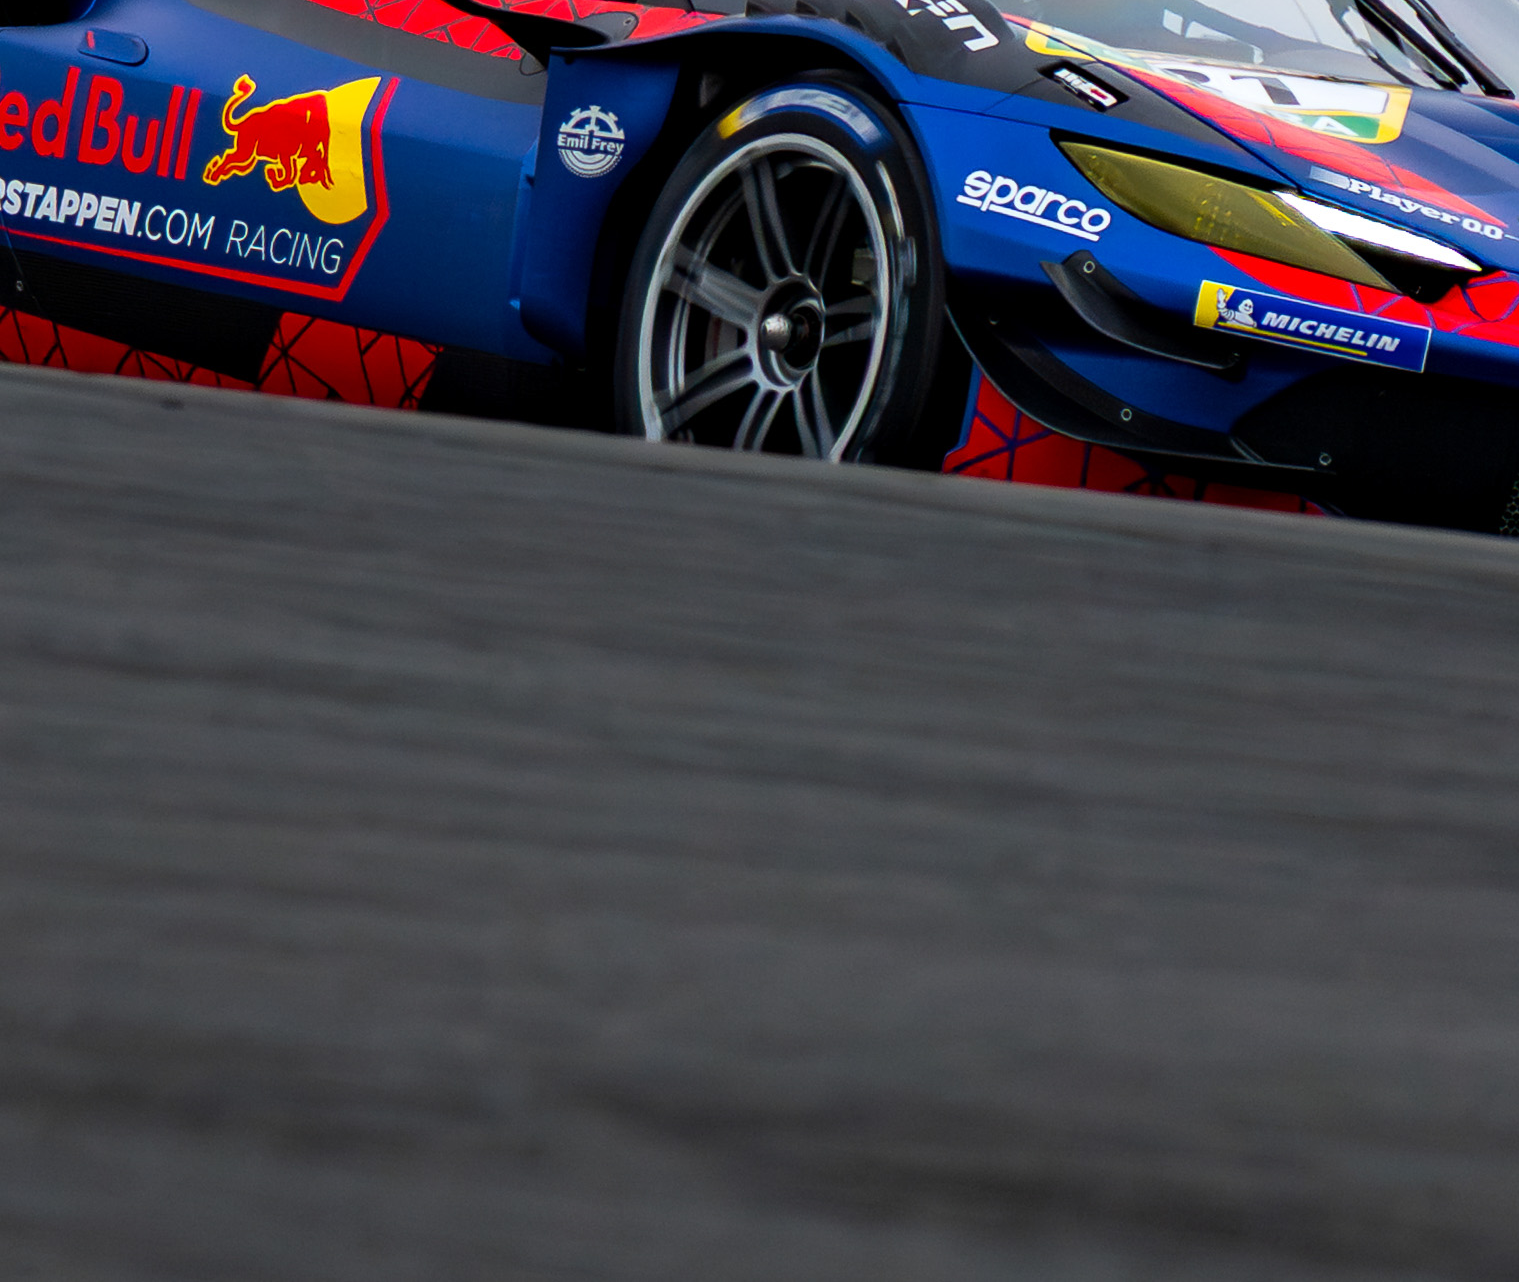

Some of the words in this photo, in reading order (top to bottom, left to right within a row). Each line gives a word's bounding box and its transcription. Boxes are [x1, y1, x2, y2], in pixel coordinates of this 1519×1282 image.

[77, 74, 203, 181] Bull
[557, 133, 590, 150] Emil
[591, 137, 625, 156] Frey
[961, 170, 1112, 234] sparco
[1346, 176, 1461, 225] Player
[225, 220, 344, 275] RACING
[1261, 311, 1401, 353] MICHELIN
